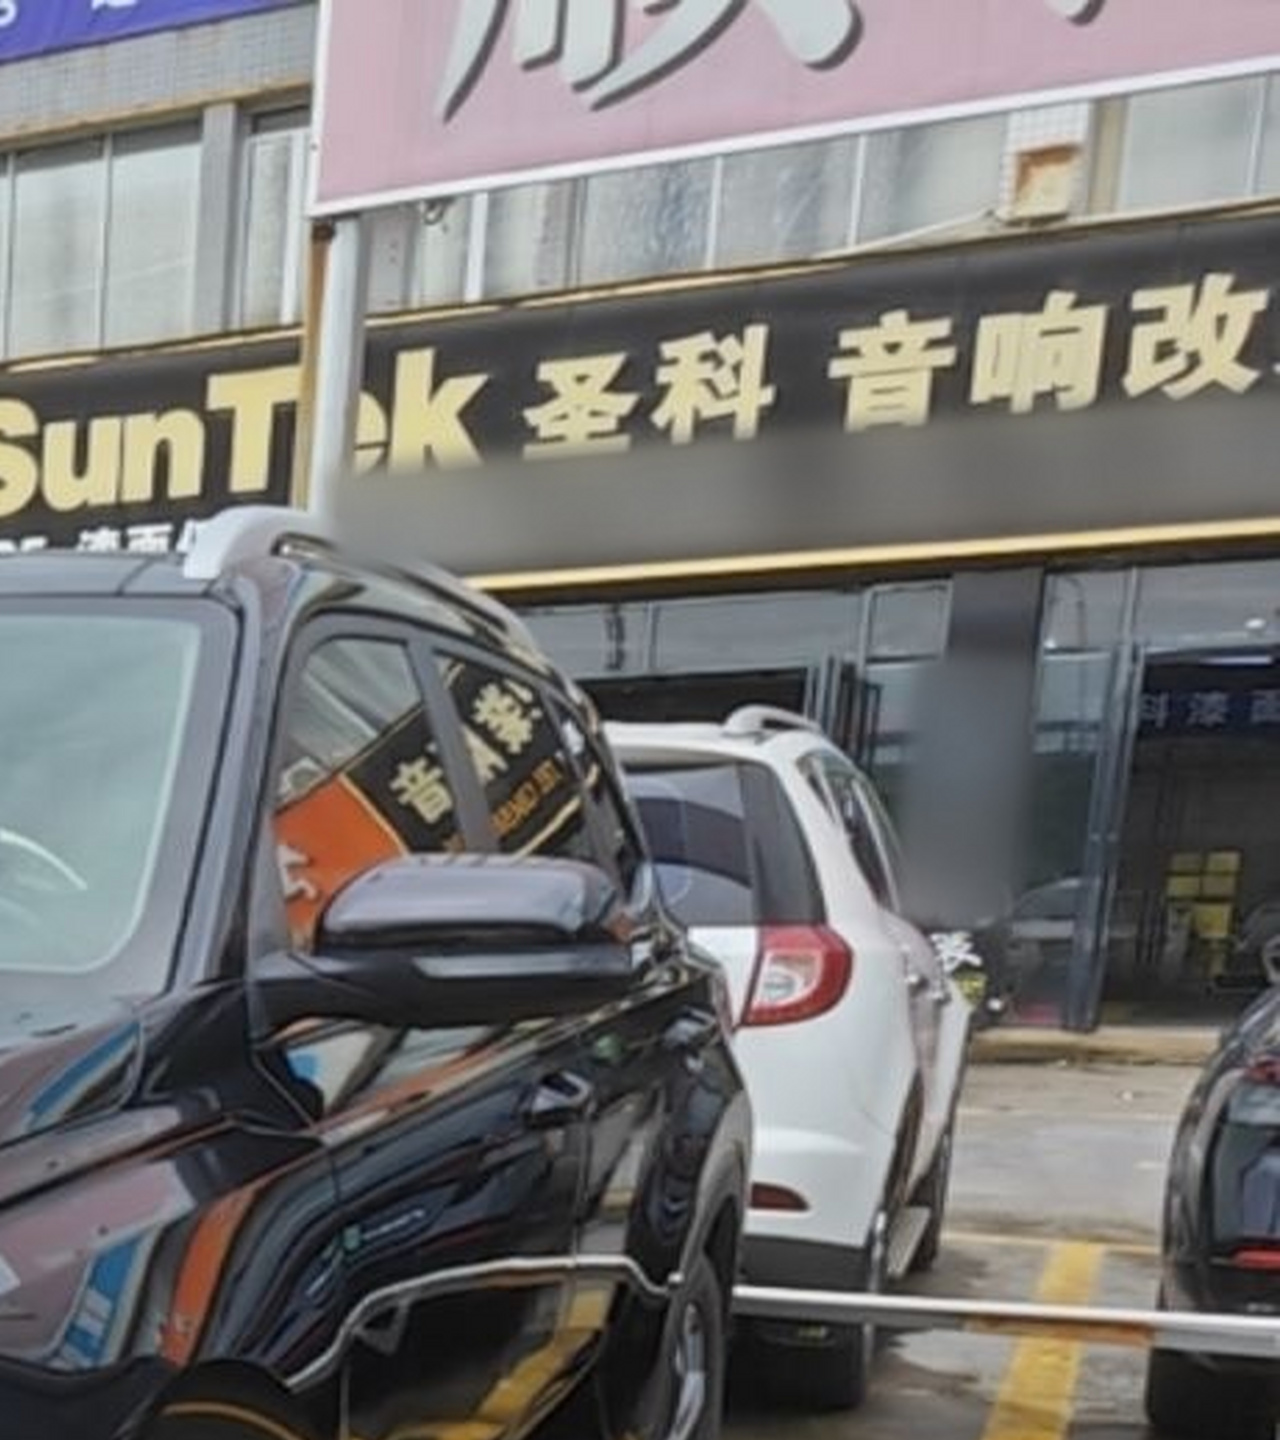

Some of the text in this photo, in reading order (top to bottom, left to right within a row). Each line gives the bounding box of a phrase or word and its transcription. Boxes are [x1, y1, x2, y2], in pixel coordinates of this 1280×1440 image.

[523, 273, 1280, 460] 圣科 音响改
